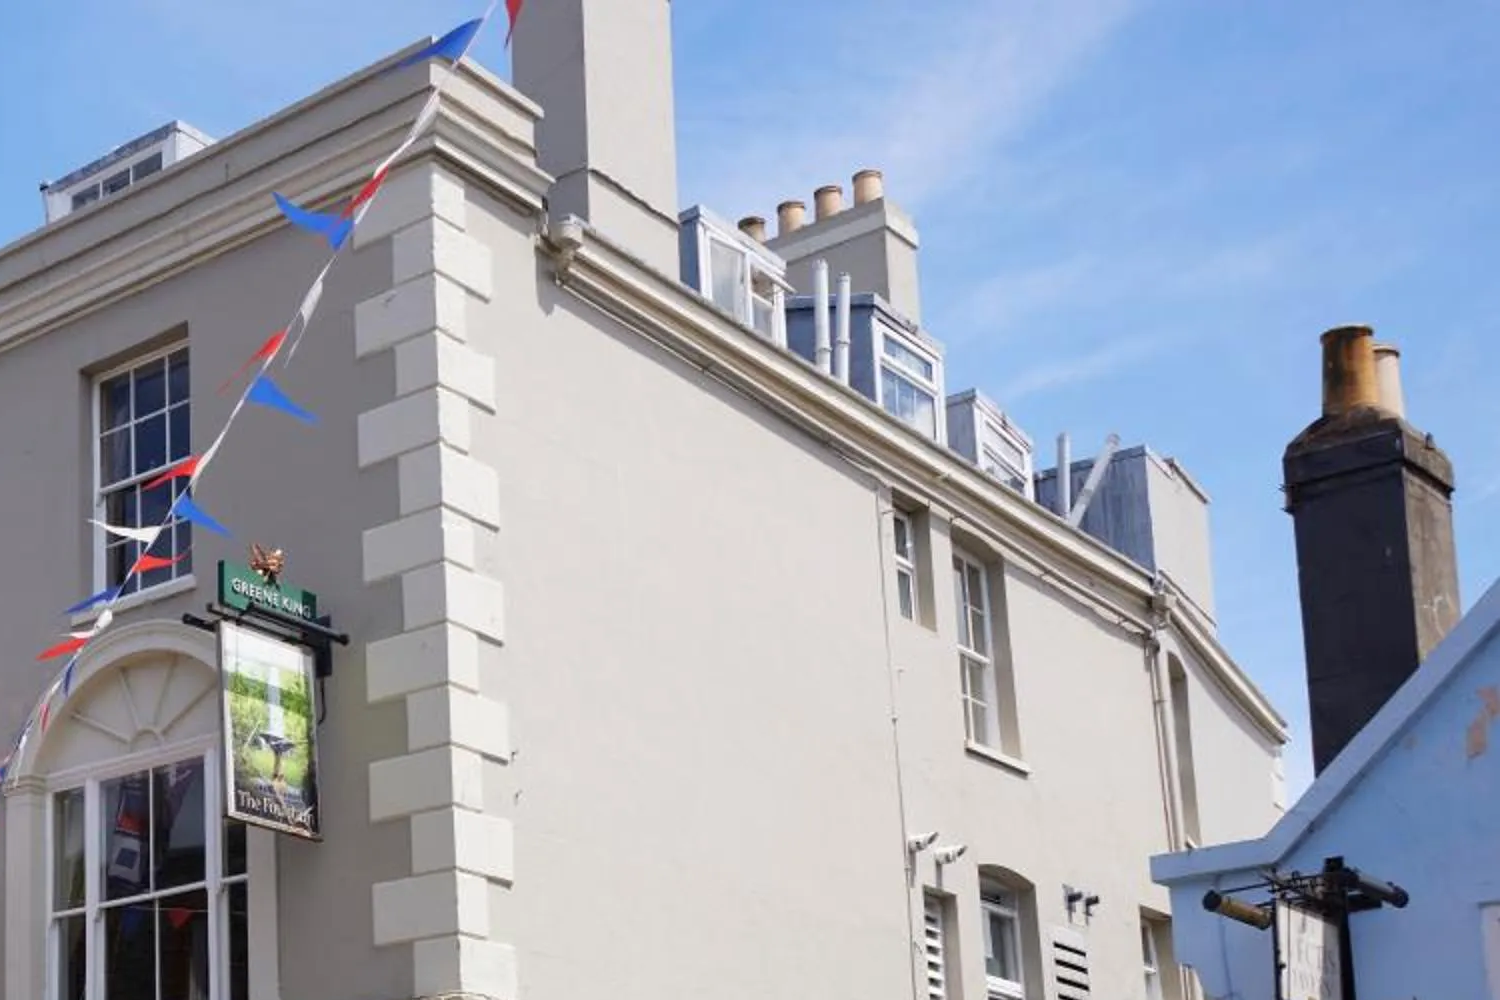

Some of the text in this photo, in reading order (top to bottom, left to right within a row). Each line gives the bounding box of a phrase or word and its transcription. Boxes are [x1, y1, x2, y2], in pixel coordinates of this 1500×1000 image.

[231, 577, 311, 619] GREENE KING
[237, 789, 261, 813] The
